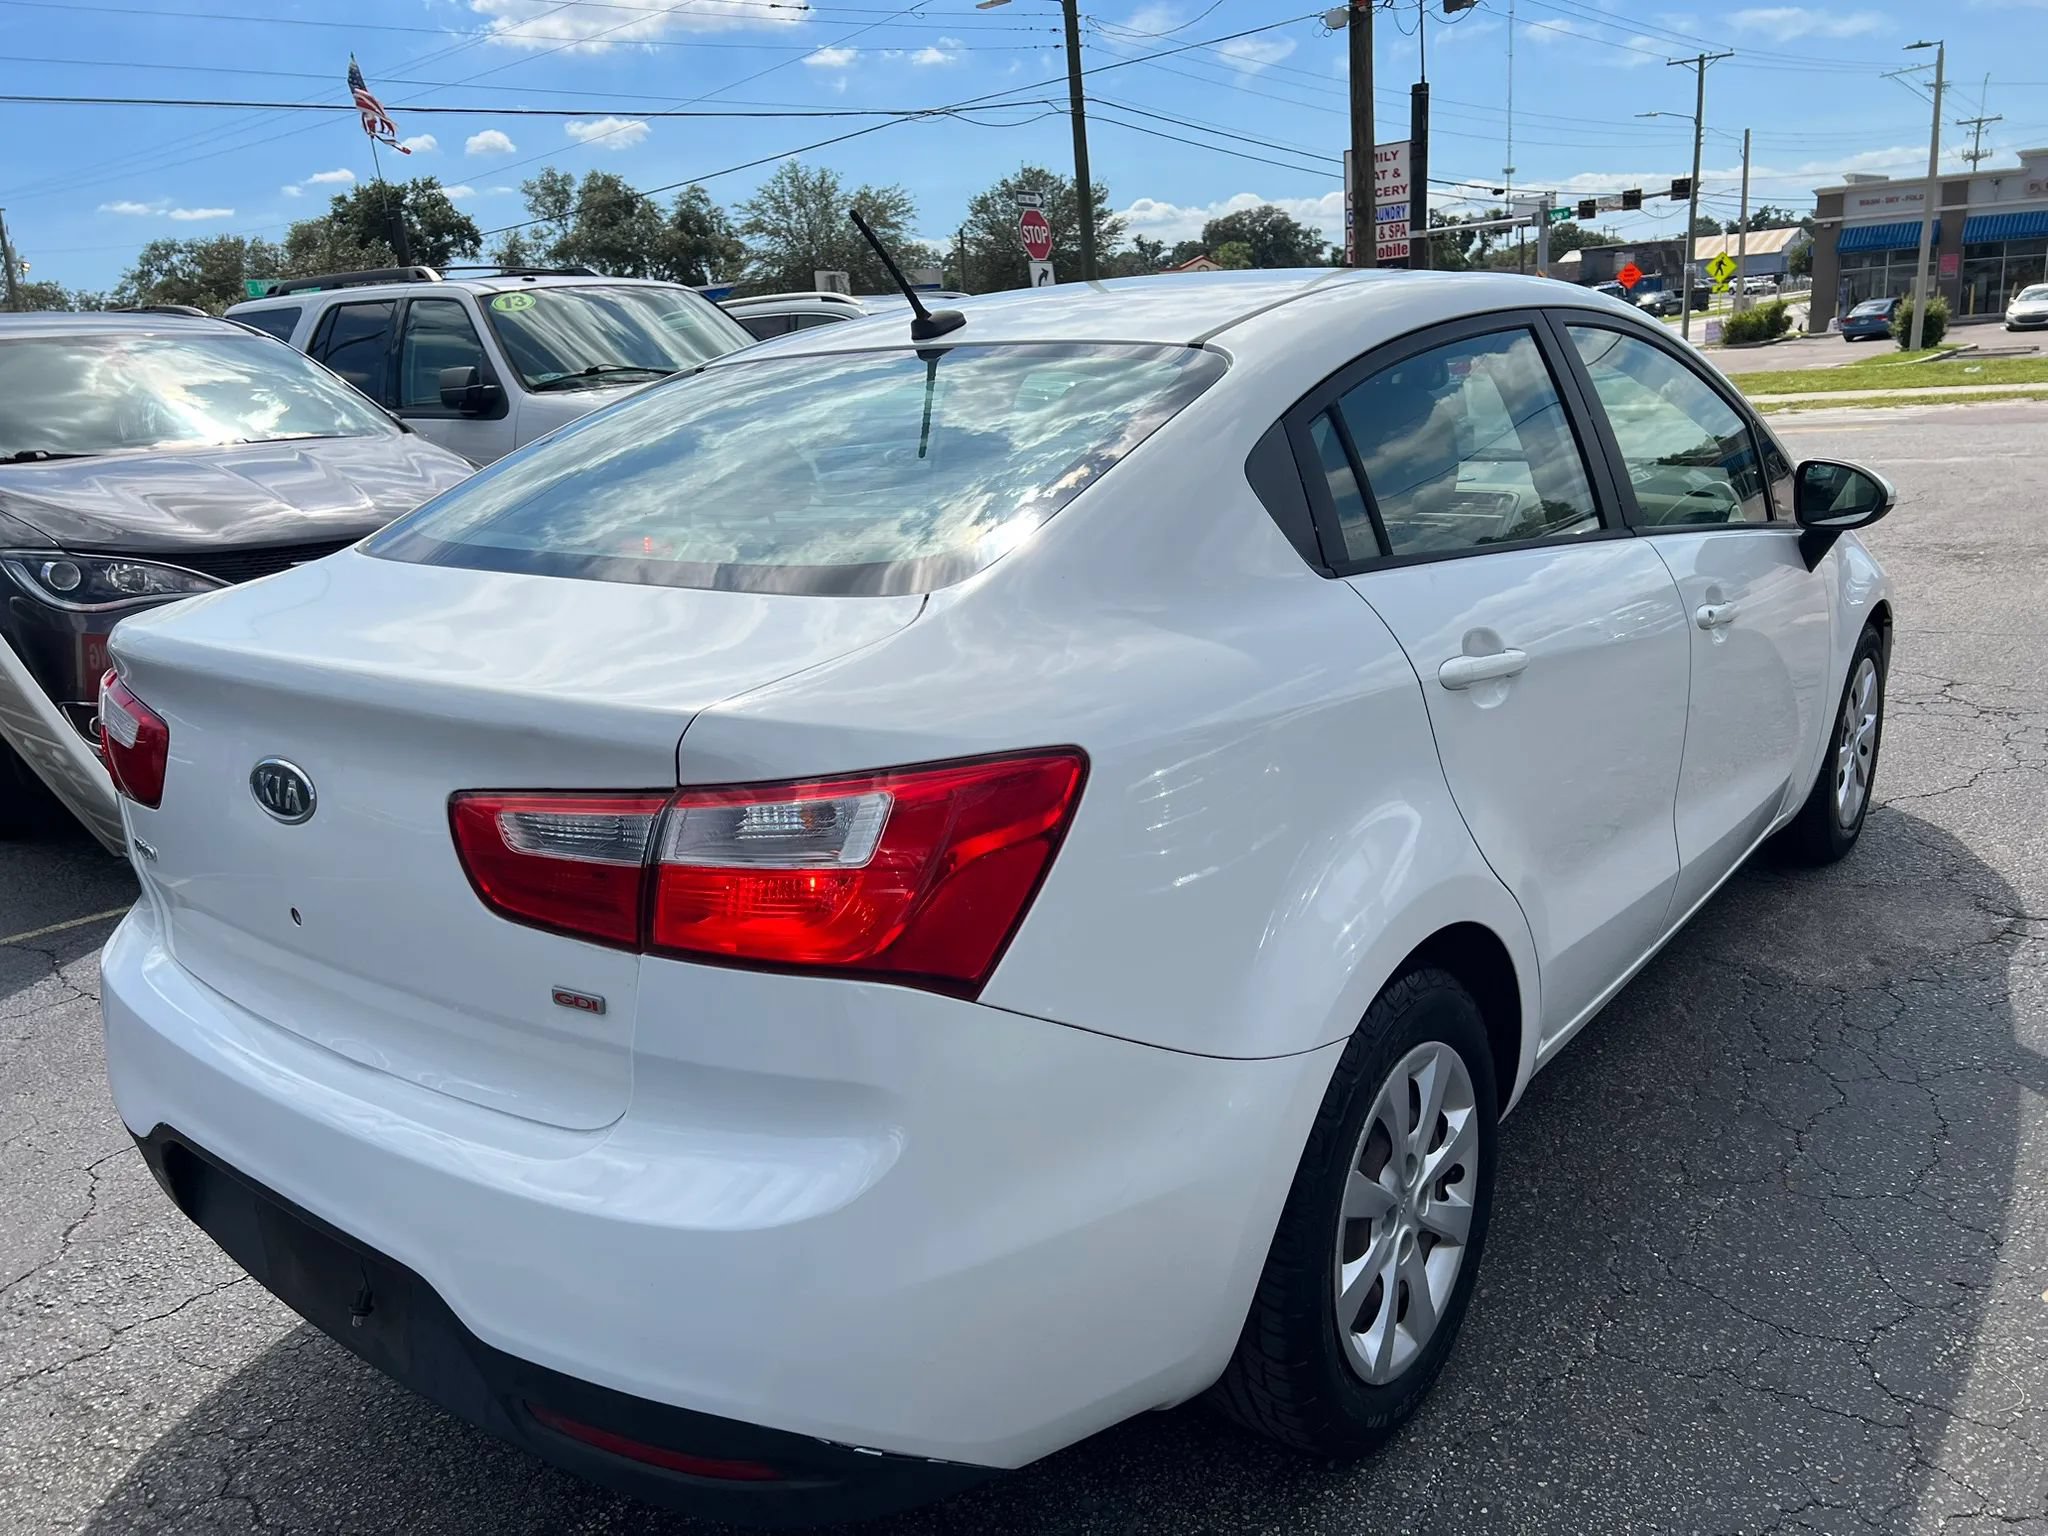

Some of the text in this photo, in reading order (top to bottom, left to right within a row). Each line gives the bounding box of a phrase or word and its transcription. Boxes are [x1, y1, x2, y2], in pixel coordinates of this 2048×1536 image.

[1375, 150, 1399, 163] ILY
[1392, 167, 1401, 179] &
[1375, 204, 1407, 221] AUNDRY
[1022, 225, 1048, 244] STOP
[1388, 223, 1407, 238] SPA
[1378, 243, 1408, 258] obile
[502, 295, 528, 309] 13
[259, 771, 303, 812] KIA
[555, 992, 598, 1011] GDI
